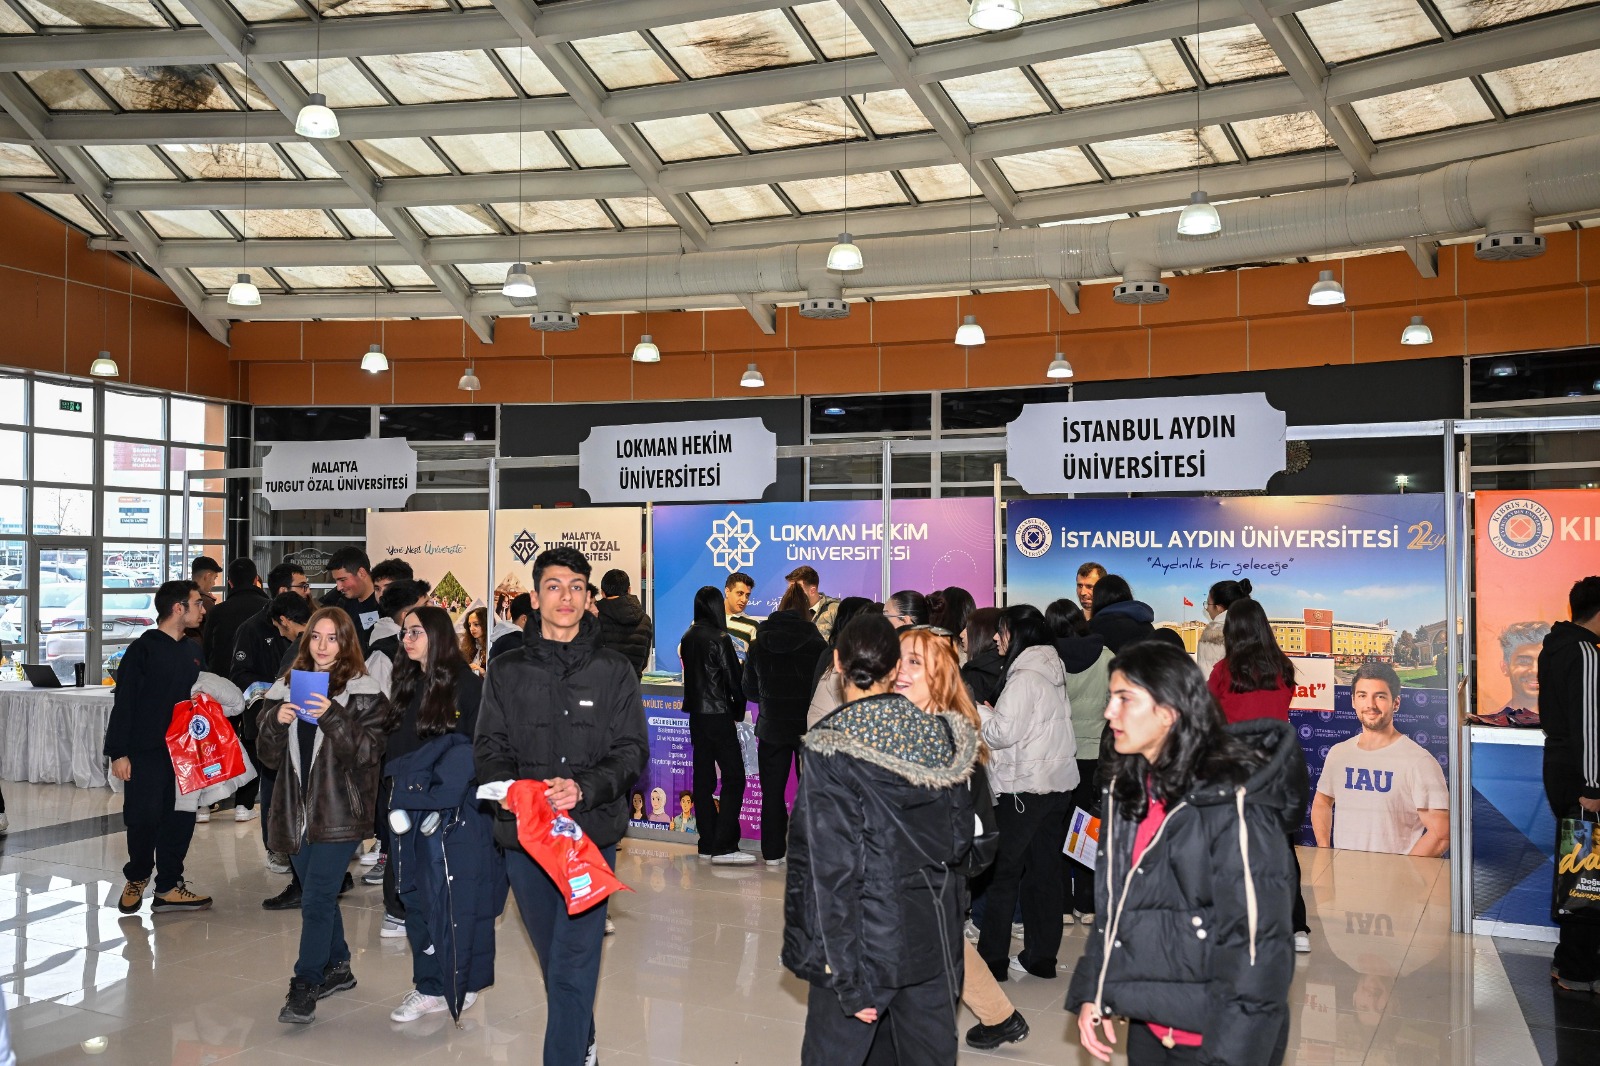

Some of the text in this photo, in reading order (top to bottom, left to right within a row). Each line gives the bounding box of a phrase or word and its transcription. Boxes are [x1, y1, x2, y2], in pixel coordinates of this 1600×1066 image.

[1063, 415, 1235, 443] İSTANBUL AYDIN
[616, 430, 732, 458] LOKMAN HEKİM
[311, 461, 358, 474] MALATYA
[1063, 449, 1205, 480] ÜNİVERSİTESİ
[265, 474, 408, 493] TURGUT ÖZAL ÜNİVERSİTESİ
[619, 462, 721, 489] ÜNİVERSİTESİ
[1492, 501, 1549, 522] KIBRIS AYDIN
[561, 532, 601, 540] MALATYA
[770, 524, 856, 542] LOKMAN
[1061, 527, 1162, 548] İSTANBUL
[1168, 530, 1235, 548] AYDIN
[1241, 525, 1399, 548] ÜNİVERSİTESİ
[1407, 520, 1433, 550] 22
[590, 540, 620, 551] ÖZAL
[786, 543, 910, 561] ÜNİVERSİTSİ
[1210, 558, 1230, 570] bir
[1344, 767, 1394, 793] IAU
[1576, 883, 1600, 892] Akden
